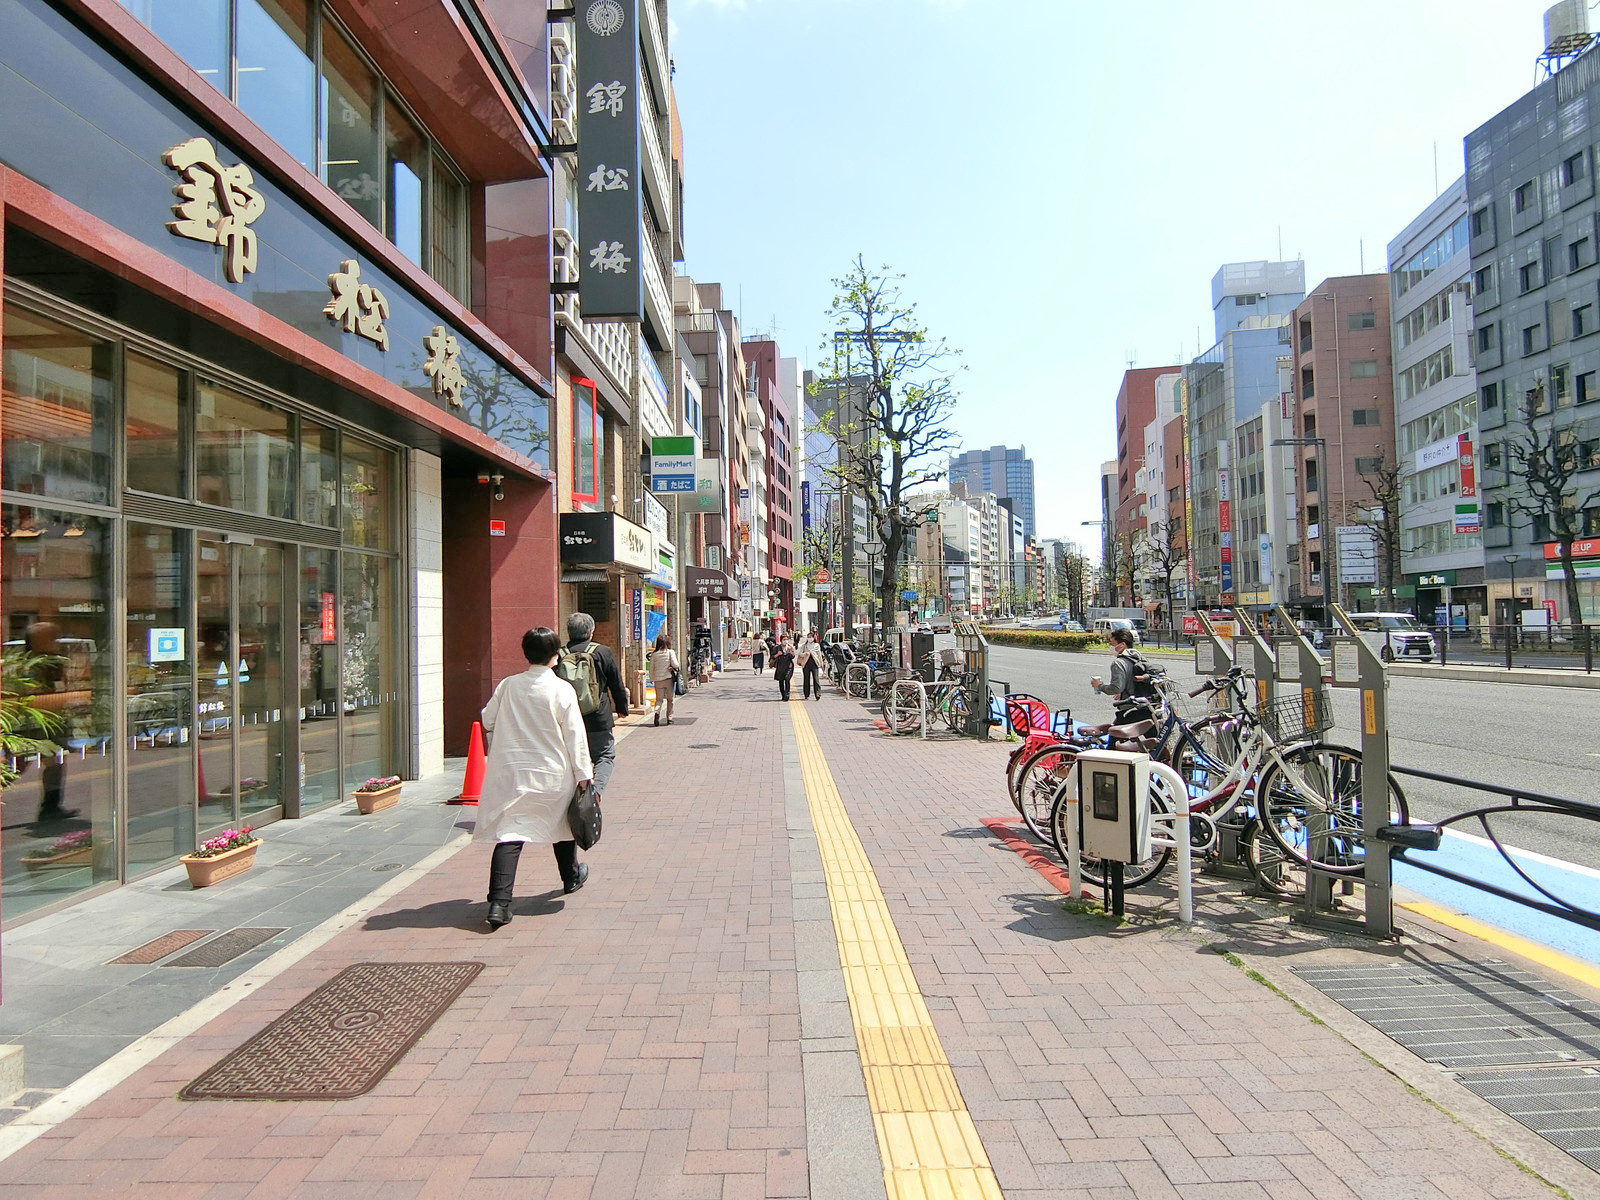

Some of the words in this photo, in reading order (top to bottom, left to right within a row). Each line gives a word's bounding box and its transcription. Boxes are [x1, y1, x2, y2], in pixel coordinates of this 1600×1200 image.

[586, 80, 632, 274] 錦松梅
[160, 137, 467, 408] 錦松梅
[654, 461, 692, 469] FamilyMart
[657, 480, 668, 490] 酒
[670, 480, 691, 490] たばこ
[1462, 486, 1474, 495] 2F
[1580, 543, 1592, 551] UP
[1419, 576, 1428, 585] Bio
